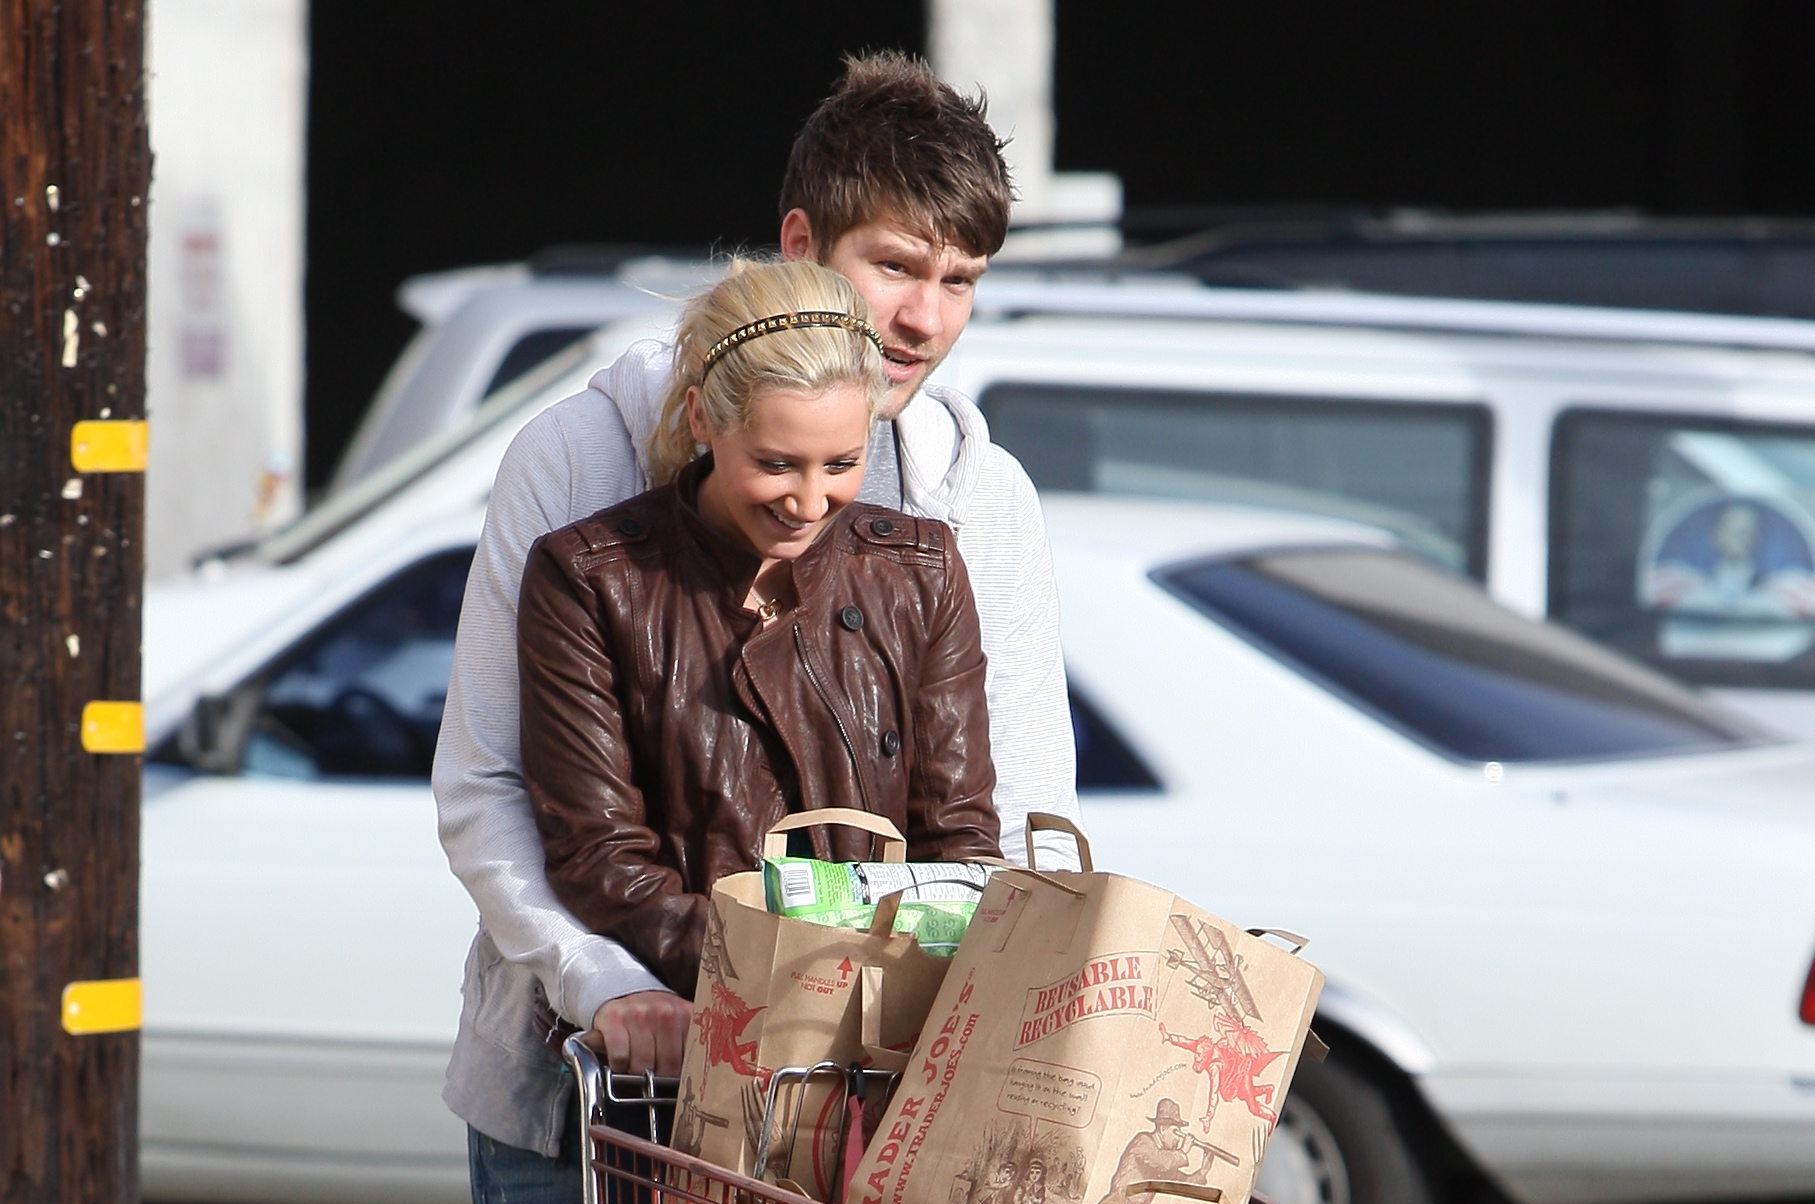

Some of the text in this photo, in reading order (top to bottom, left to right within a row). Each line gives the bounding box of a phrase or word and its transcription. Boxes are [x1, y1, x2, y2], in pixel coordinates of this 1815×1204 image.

[801, 982, 834, 995] NOT OUT
[836, 980, 848, 988] UP
[1034, 956, 1142, 1014] REUSABLE
[922, 981, 974, 1087] JOE'S
[1018, 985, 1154, 1045] RECYCLABLE
